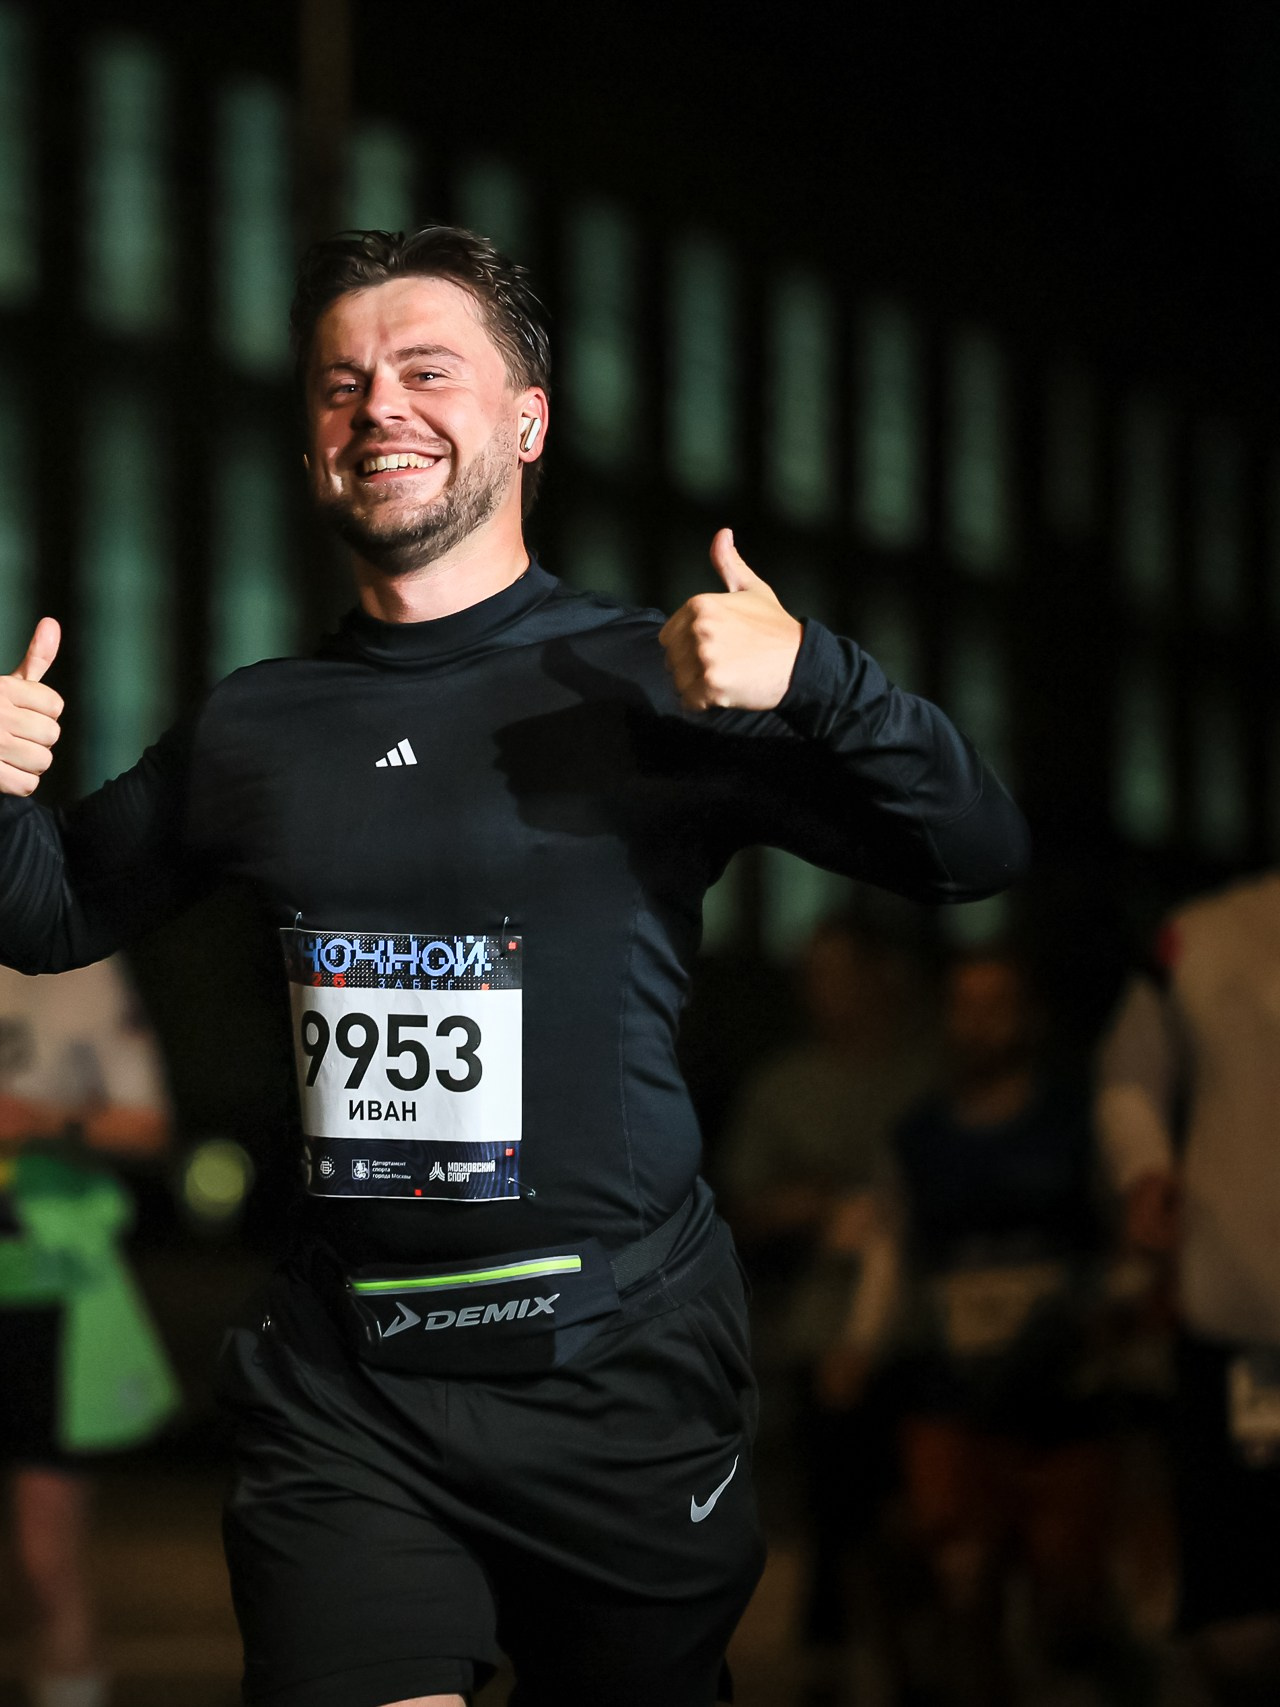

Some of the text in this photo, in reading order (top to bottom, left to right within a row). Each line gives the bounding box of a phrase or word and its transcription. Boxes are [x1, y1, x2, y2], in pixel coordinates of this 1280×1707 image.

[300, 1009, 483, 1093] 9953
[348, 1099, 417, 1122] ИВАН
[447, 1160, 496, 1173] МОСКОВСКИЙ
[447, 1172, 471, 1183] СПОРТ
[425, 1293, 561, 1331] DEMIX
